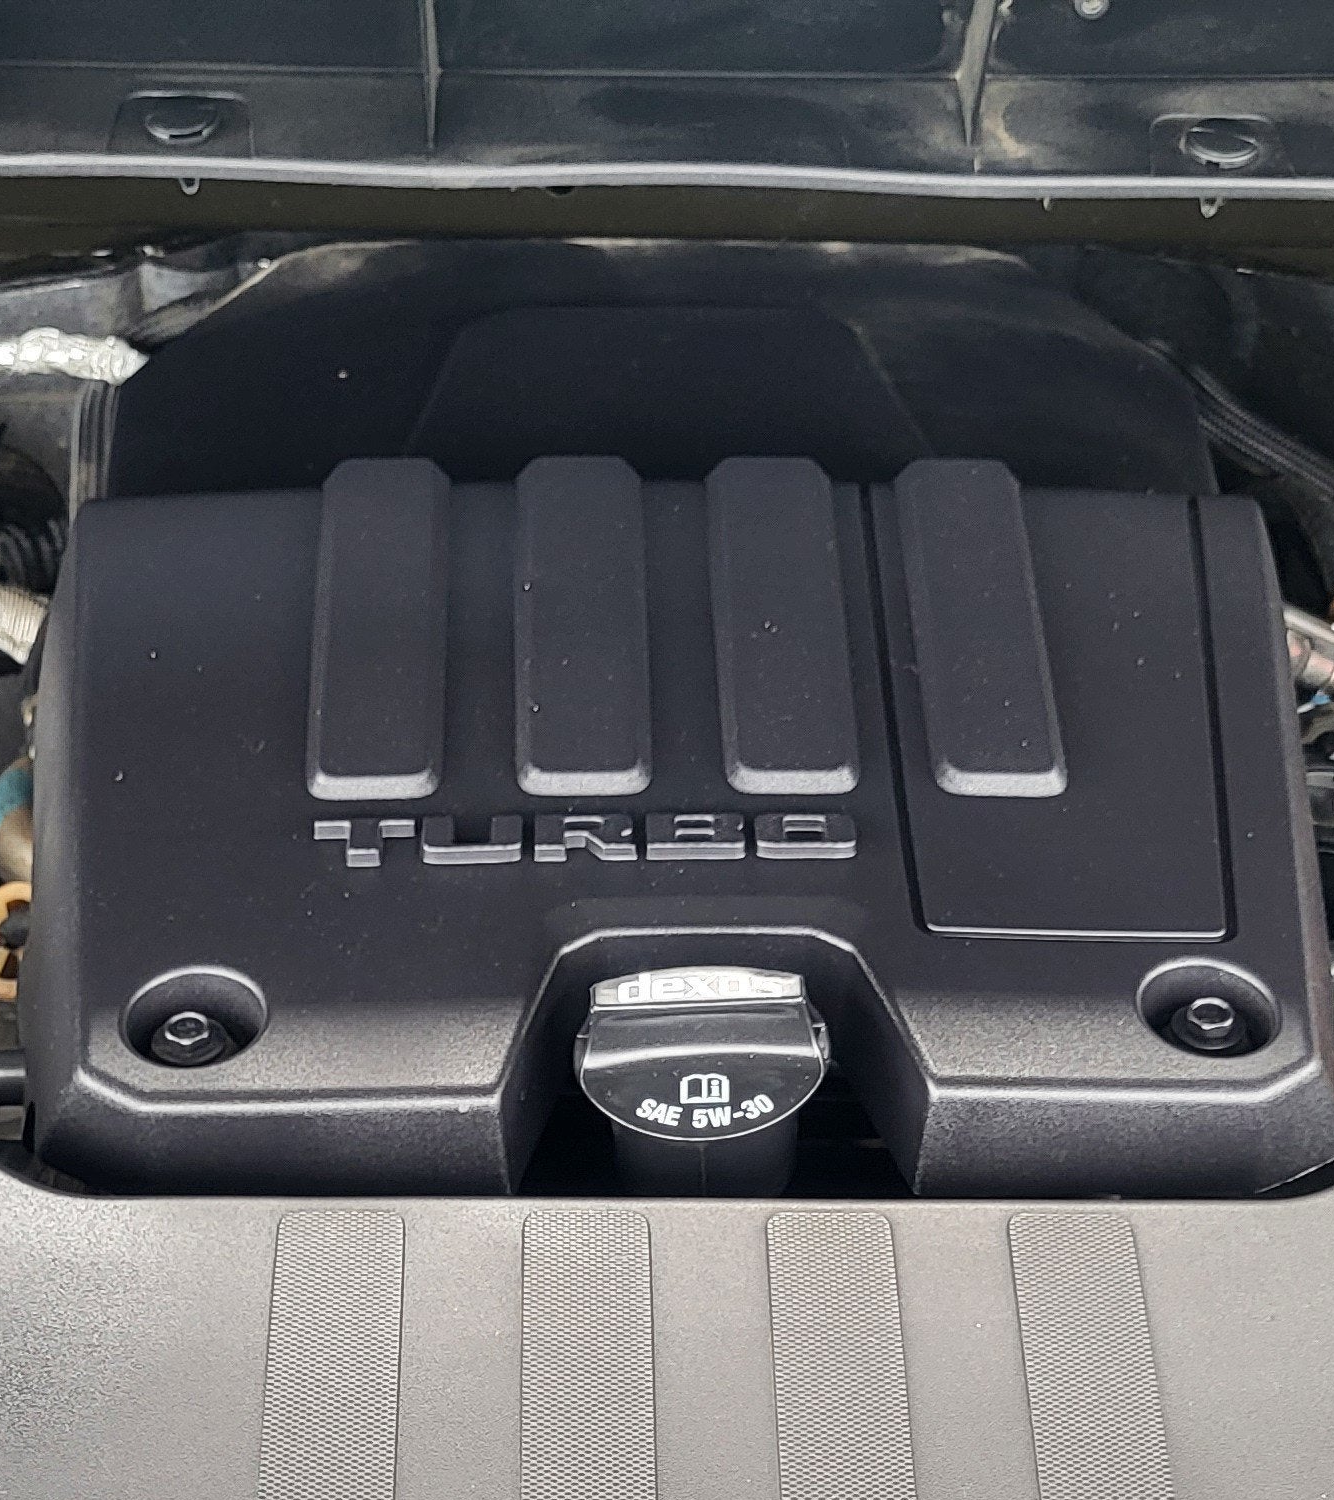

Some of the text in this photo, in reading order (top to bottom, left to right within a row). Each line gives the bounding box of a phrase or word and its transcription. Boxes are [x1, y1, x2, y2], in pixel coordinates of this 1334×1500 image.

[312, 813, 858, 868] TURBO
[617, 973, 784, 1004] dexos
[635, 1093, 775, 1129] SAE 5W-30
